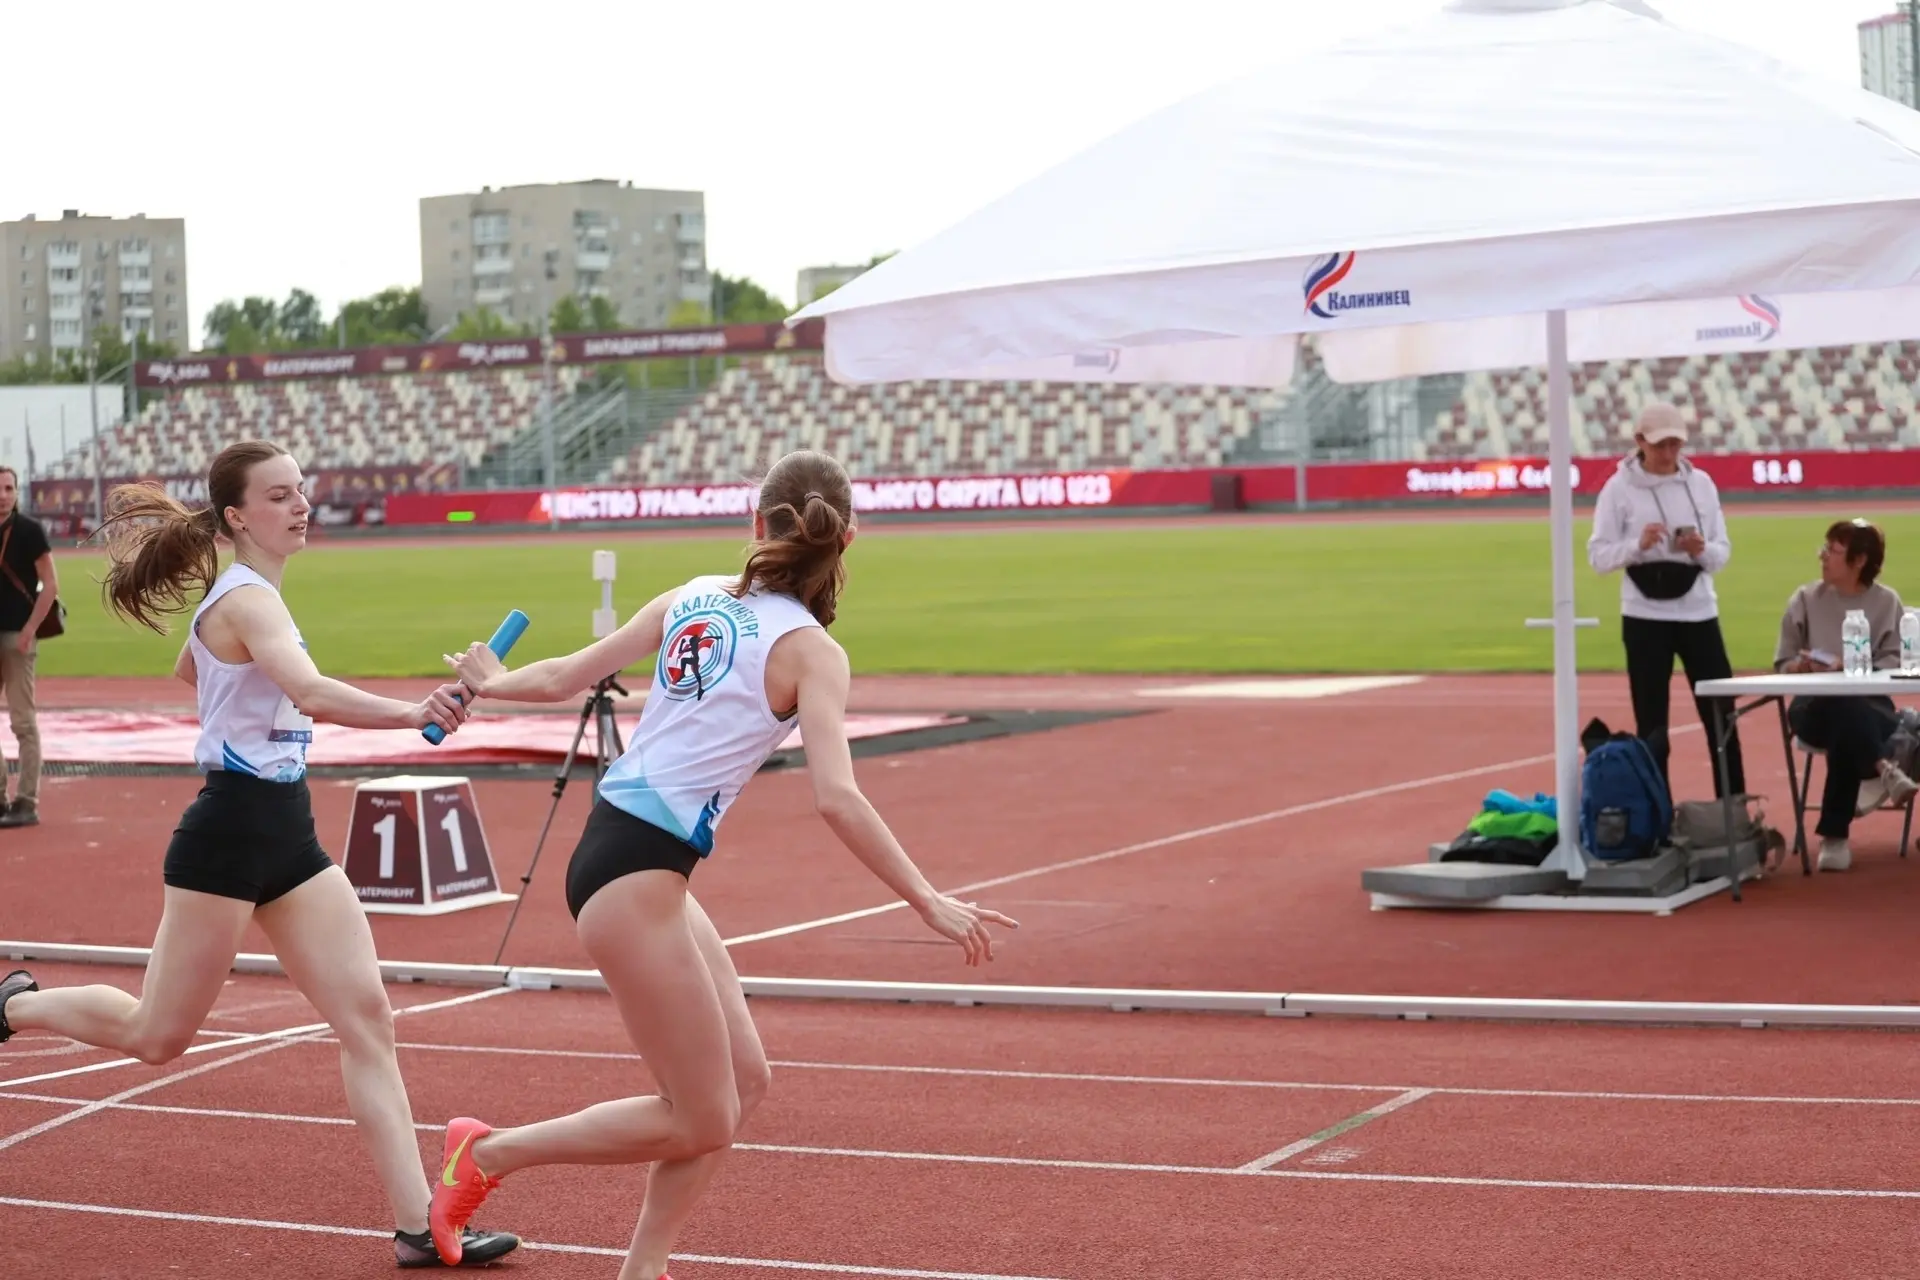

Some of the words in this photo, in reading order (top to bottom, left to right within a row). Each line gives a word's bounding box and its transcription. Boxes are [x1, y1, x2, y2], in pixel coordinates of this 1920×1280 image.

[672, 594, 759, 639] ЕКАТЕРИНБУРГ
[373, 813, 396, 879] 1
[440, 808, 468, 873] 1
